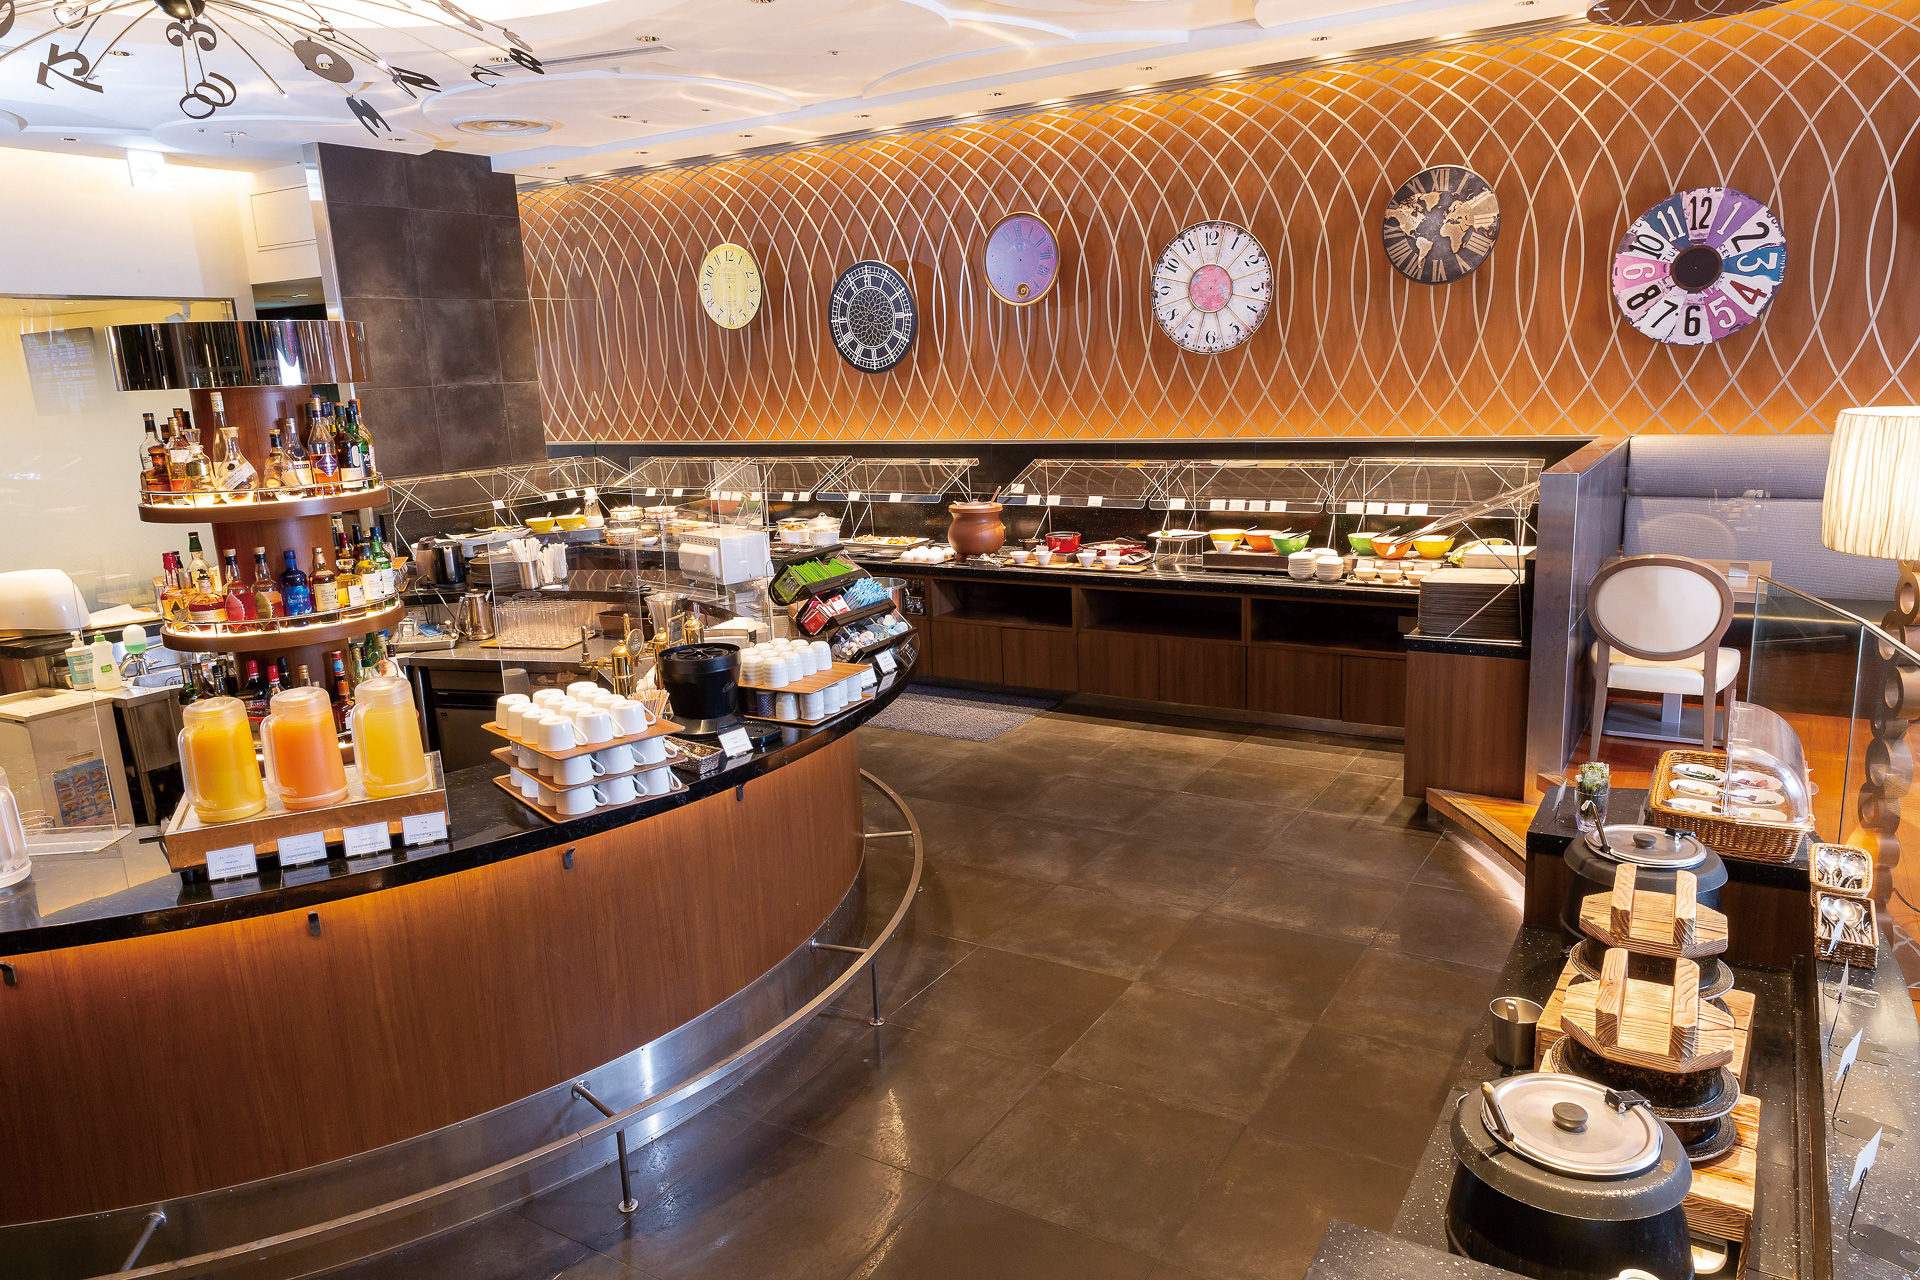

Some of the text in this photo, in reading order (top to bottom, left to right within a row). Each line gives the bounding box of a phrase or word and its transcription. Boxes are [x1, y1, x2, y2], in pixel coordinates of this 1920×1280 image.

[1430, 168, 1450, 192] XII
[1690, 196, 1712, 231] 12
[1716, 201, 1742, 235] 1
[1657, 205, 1686, 242] 11
[1205, 230, 1220, 246] 12
[1231, 236, 1240, 250] 1
[1731, 221, 1770, 253] 2
[1182, 238, 1196, 255] 11
[1386, 238, 1413, 268] VIII
[1628, 234, 1664, 260] 10
[713, 253, 722, 267] 11
[725, 250, 734, 262] 12
[738, 255, 743, 265] 1
[1244, 254, 1260, 267] 2
[1455, 253, 1472, 274] V
[1736, 252, 1778, 273] 3
[705, 265, 715, 278] 10
[745, 267, 755, 279] 2
[1165, 258, 1180, 273] 10
[1430, 259, 1448, 282] VI
[1622, 262, 1656, 280] 9
[702, 283, 711, 291] 9
[749, 285, 758, 293] 3
[1160, 285, 1173, 296] 9
[1729, 280, 1768, 305] 4
[706, 298, 715, 308] 8
[1627, 284, 1661, 310] 8
[717, 308, 724, 319] 7
[738, 309, 747, 322] 5
[1166, 308, 1180, 321] 8
[1246, 304, 1258, 314] 4
[1650, 299, 1678, 329] 7
[1708, 295, 1736, 329] 5
[729, 314, 735, 326] 6
[1684, 305, 1701, 336] 6
[1184, 323, 1195, 339] 7
[1228, 322, 1241, 336] 5
[1205, 330, 1216, 345] 6
